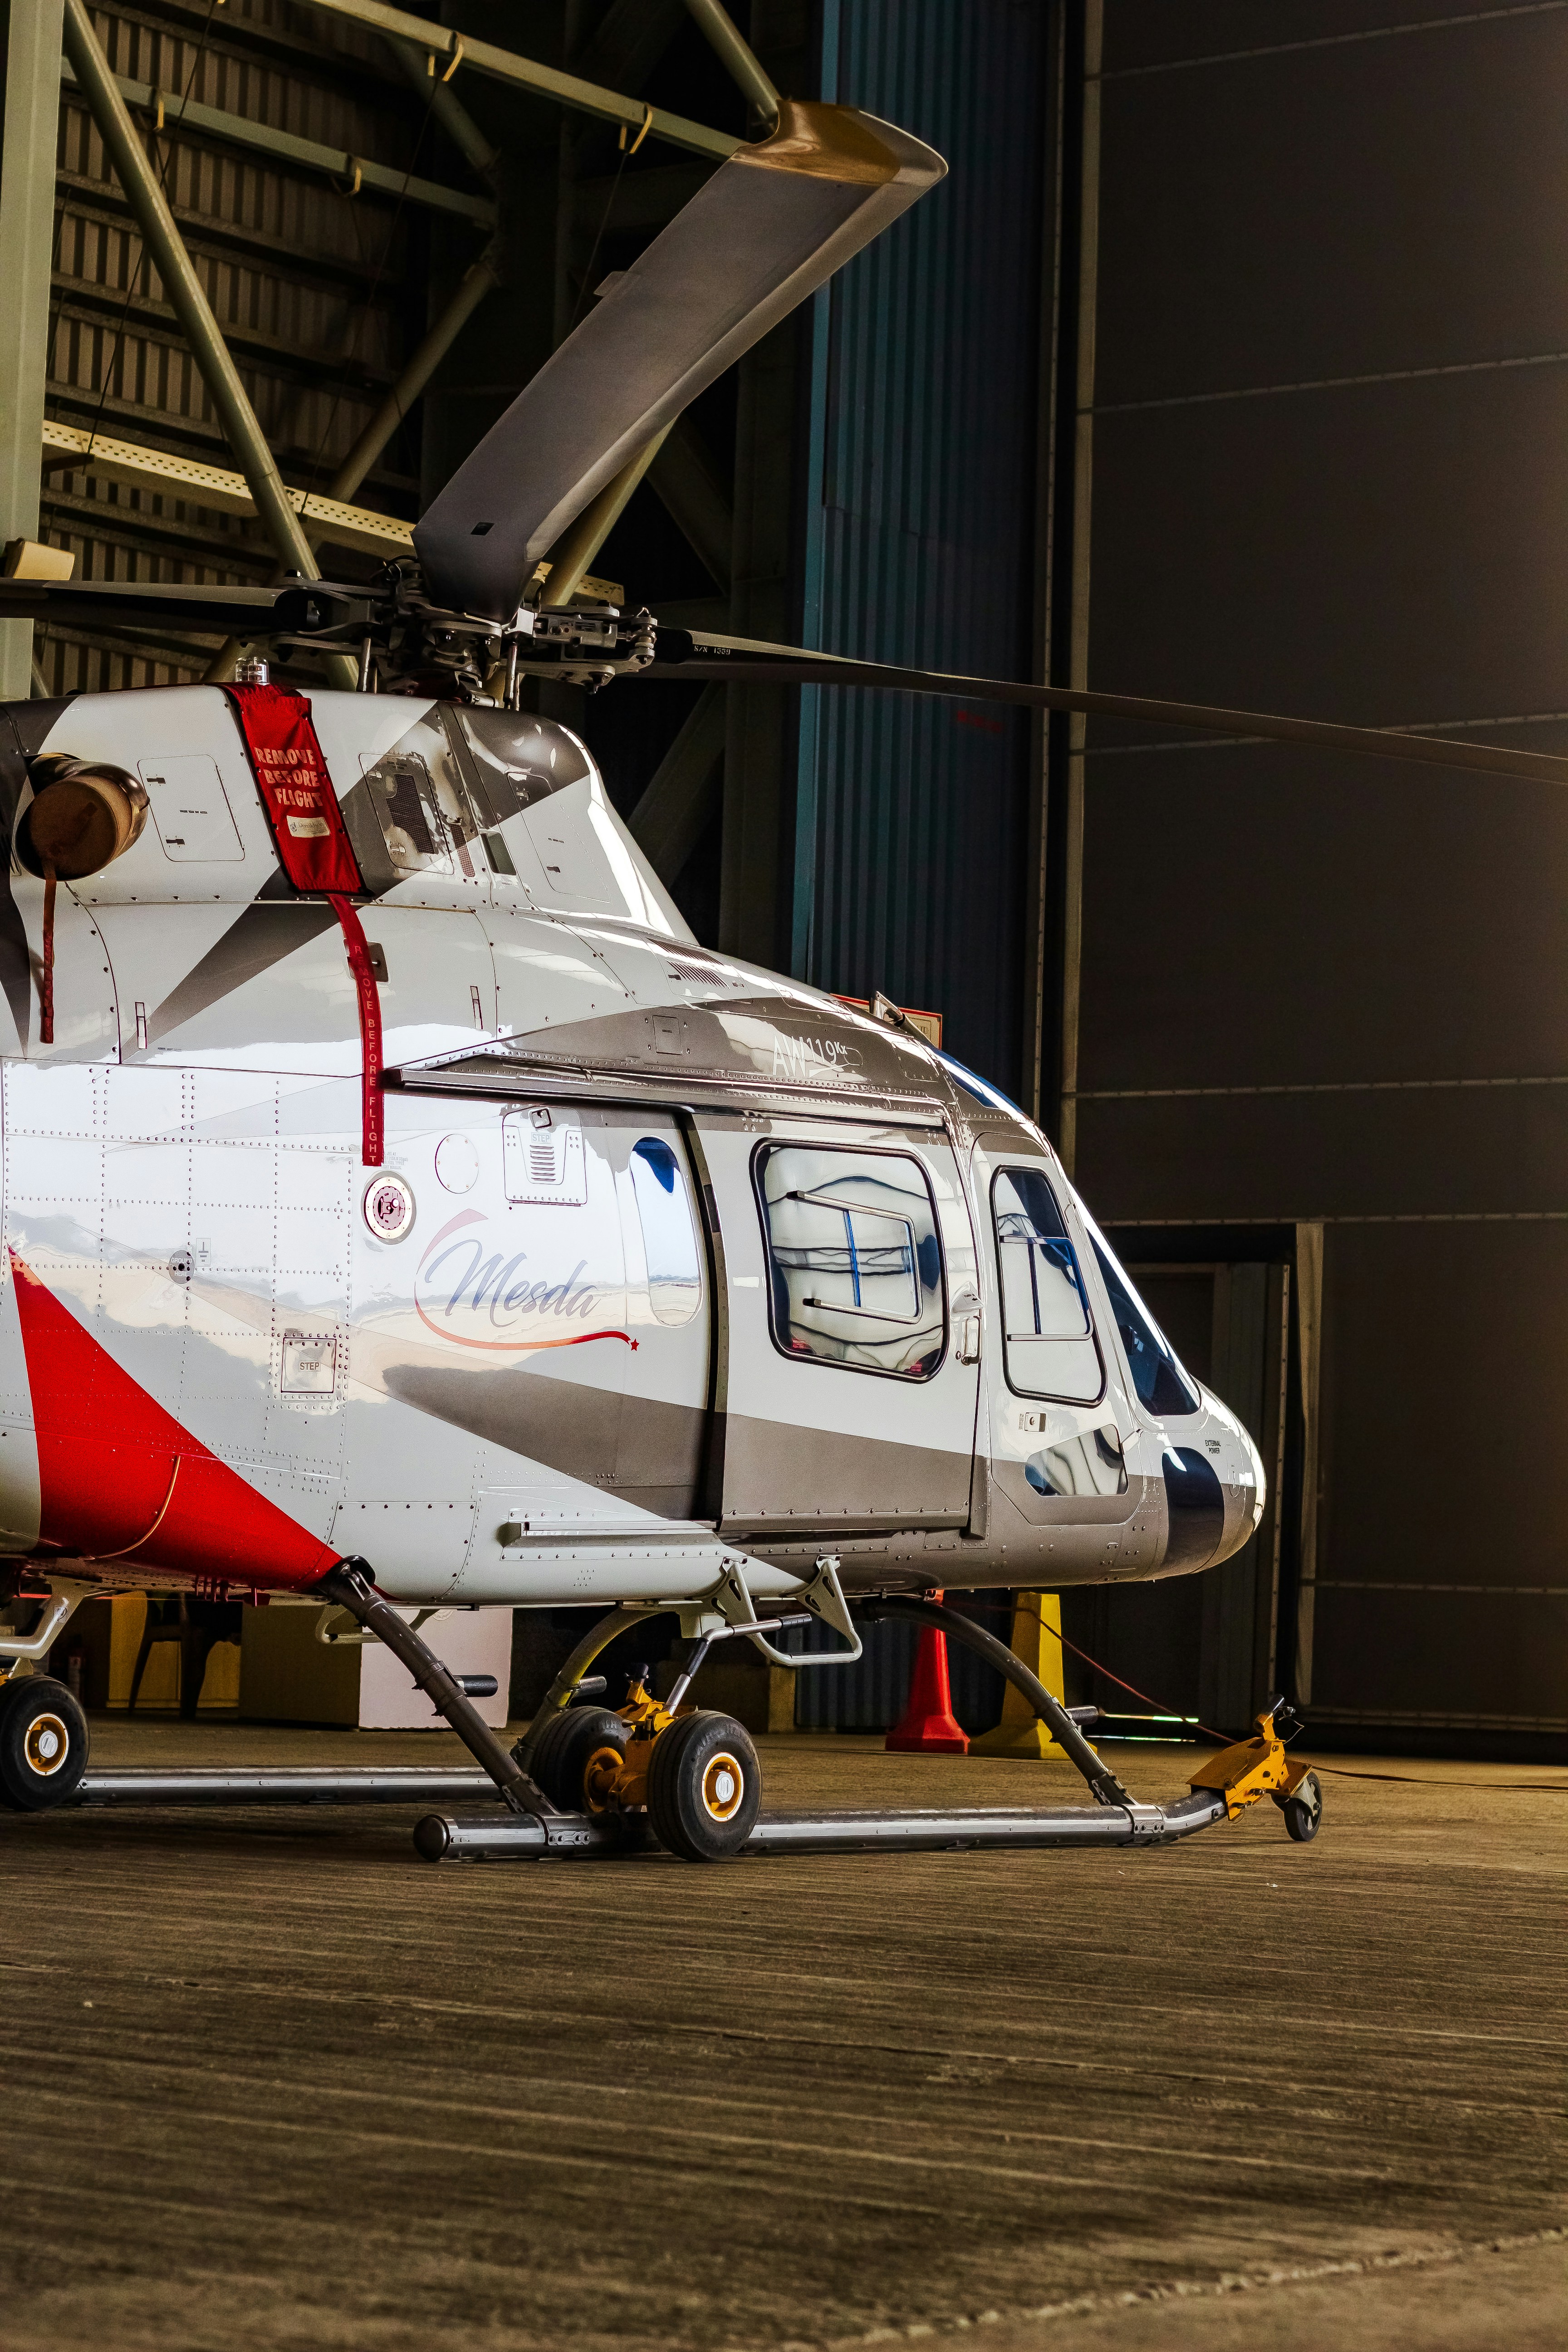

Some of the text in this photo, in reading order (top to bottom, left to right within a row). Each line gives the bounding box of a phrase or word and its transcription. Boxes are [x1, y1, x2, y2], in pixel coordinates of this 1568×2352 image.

[254, 747, 316, 764] REMOVE
[264, 769, 320, 787] BEFORE
[274, 789, 323, 808] FLIGHT
[354, 946, 377, 1162] REMOVE BEFORE FLIGHT
[532, 1133, 549, 1142] STEP
[425, 1239, 601, 1328] Mesda
[299, 1362, 319, 1370] STEP
